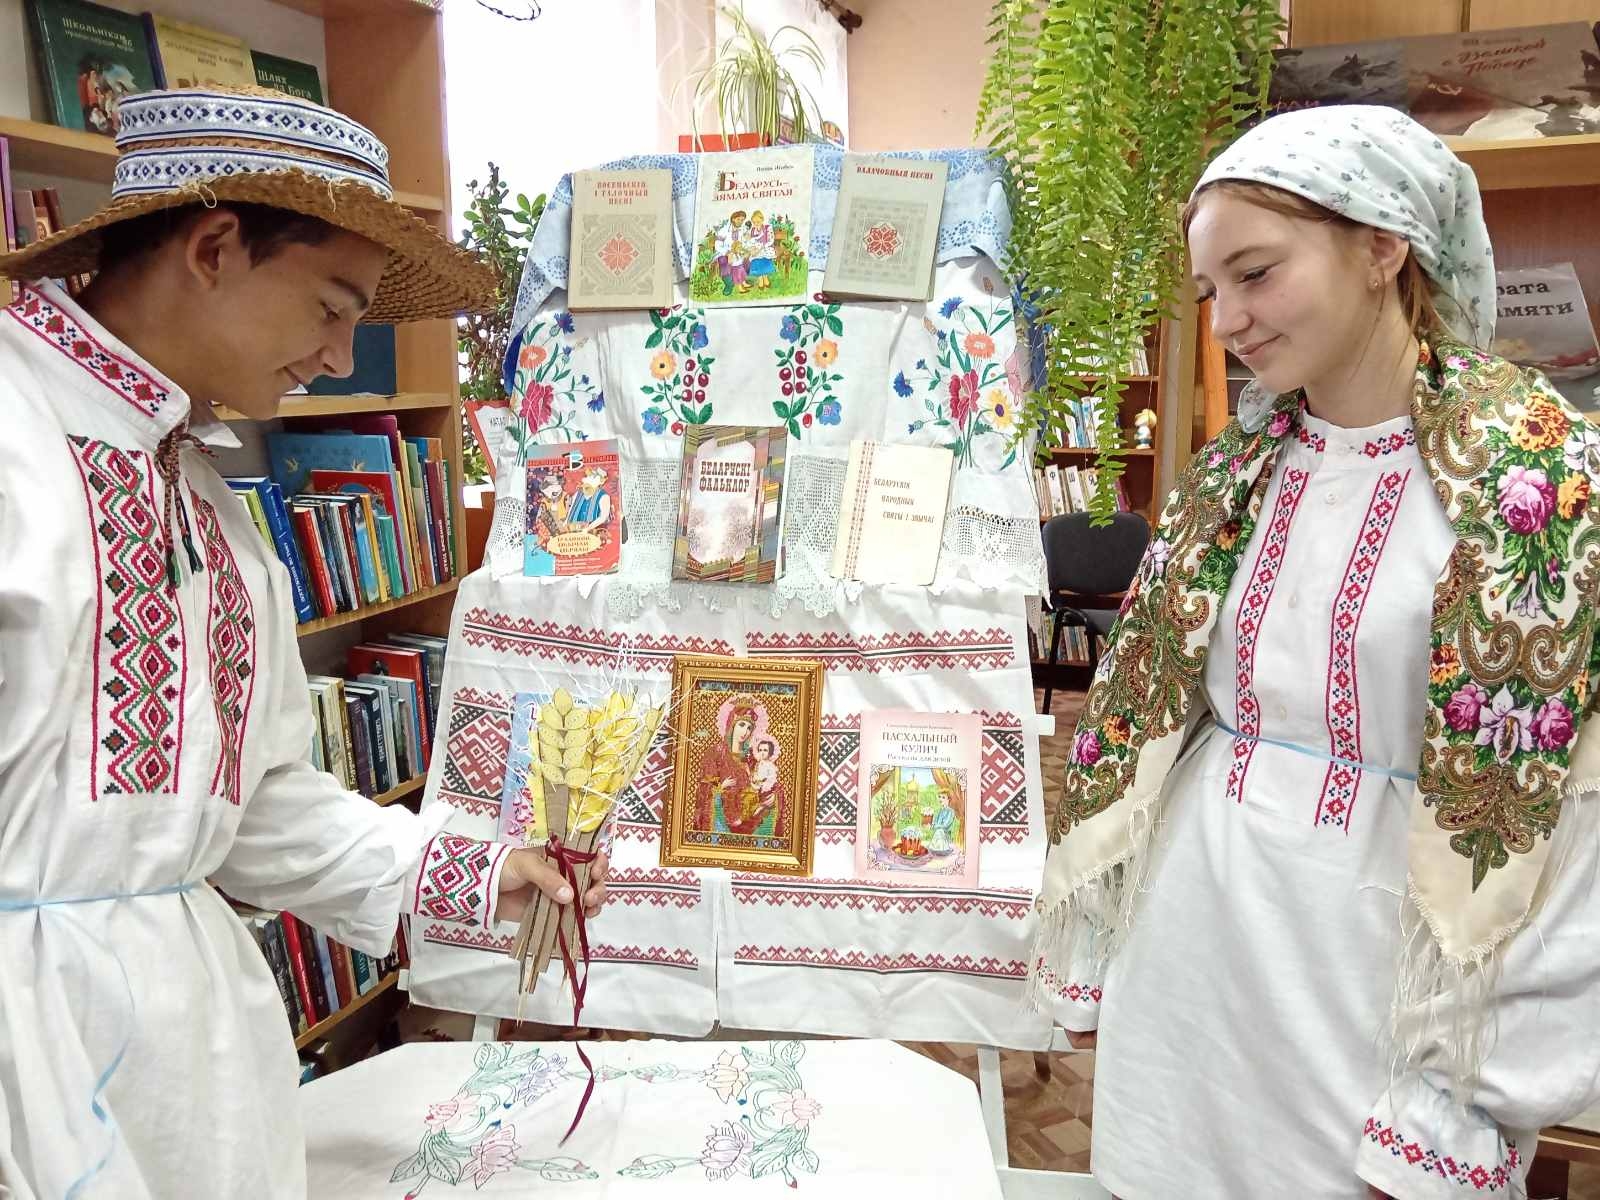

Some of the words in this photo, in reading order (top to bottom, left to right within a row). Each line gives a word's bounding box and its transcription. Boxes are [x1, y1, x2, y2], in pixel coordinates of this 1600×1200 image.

[1496, 282, 1551, 295] рата
[700, 461, 751, 476] БЕЛАРУСКІ
[699, 477, 750, 492] ФАЛЬКЛОР
[882, 731, 959, 744] ПАСХАЛЬНЫЙ
[901, 743, 938, 754] КУЛИЧ
